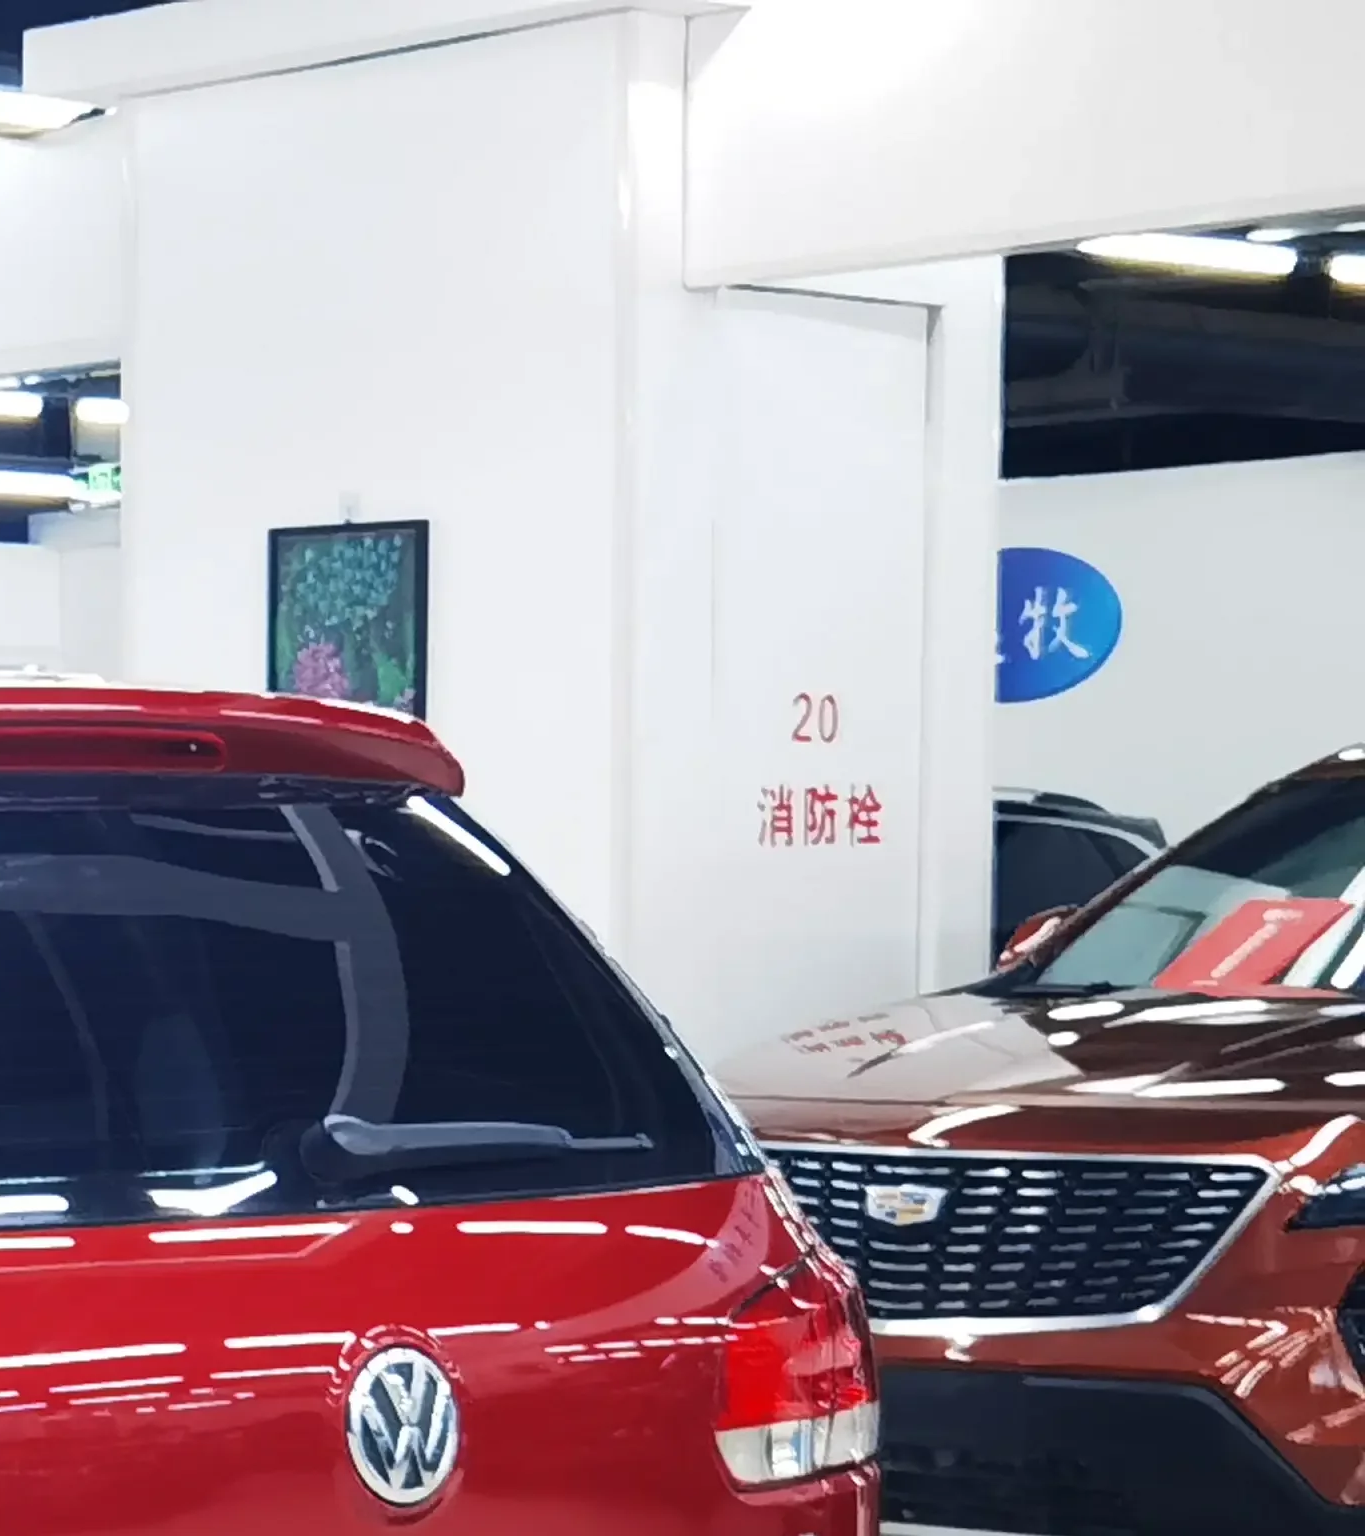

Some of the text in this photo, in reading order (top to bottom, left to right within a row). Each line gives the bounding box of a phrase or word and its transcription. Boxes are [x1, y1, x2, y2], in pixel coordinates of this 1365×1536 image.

[996, 586, 1090, 661] 牧
[791, 692, 839, 743] 20
[757, 782, 882, 847] 消防栓
